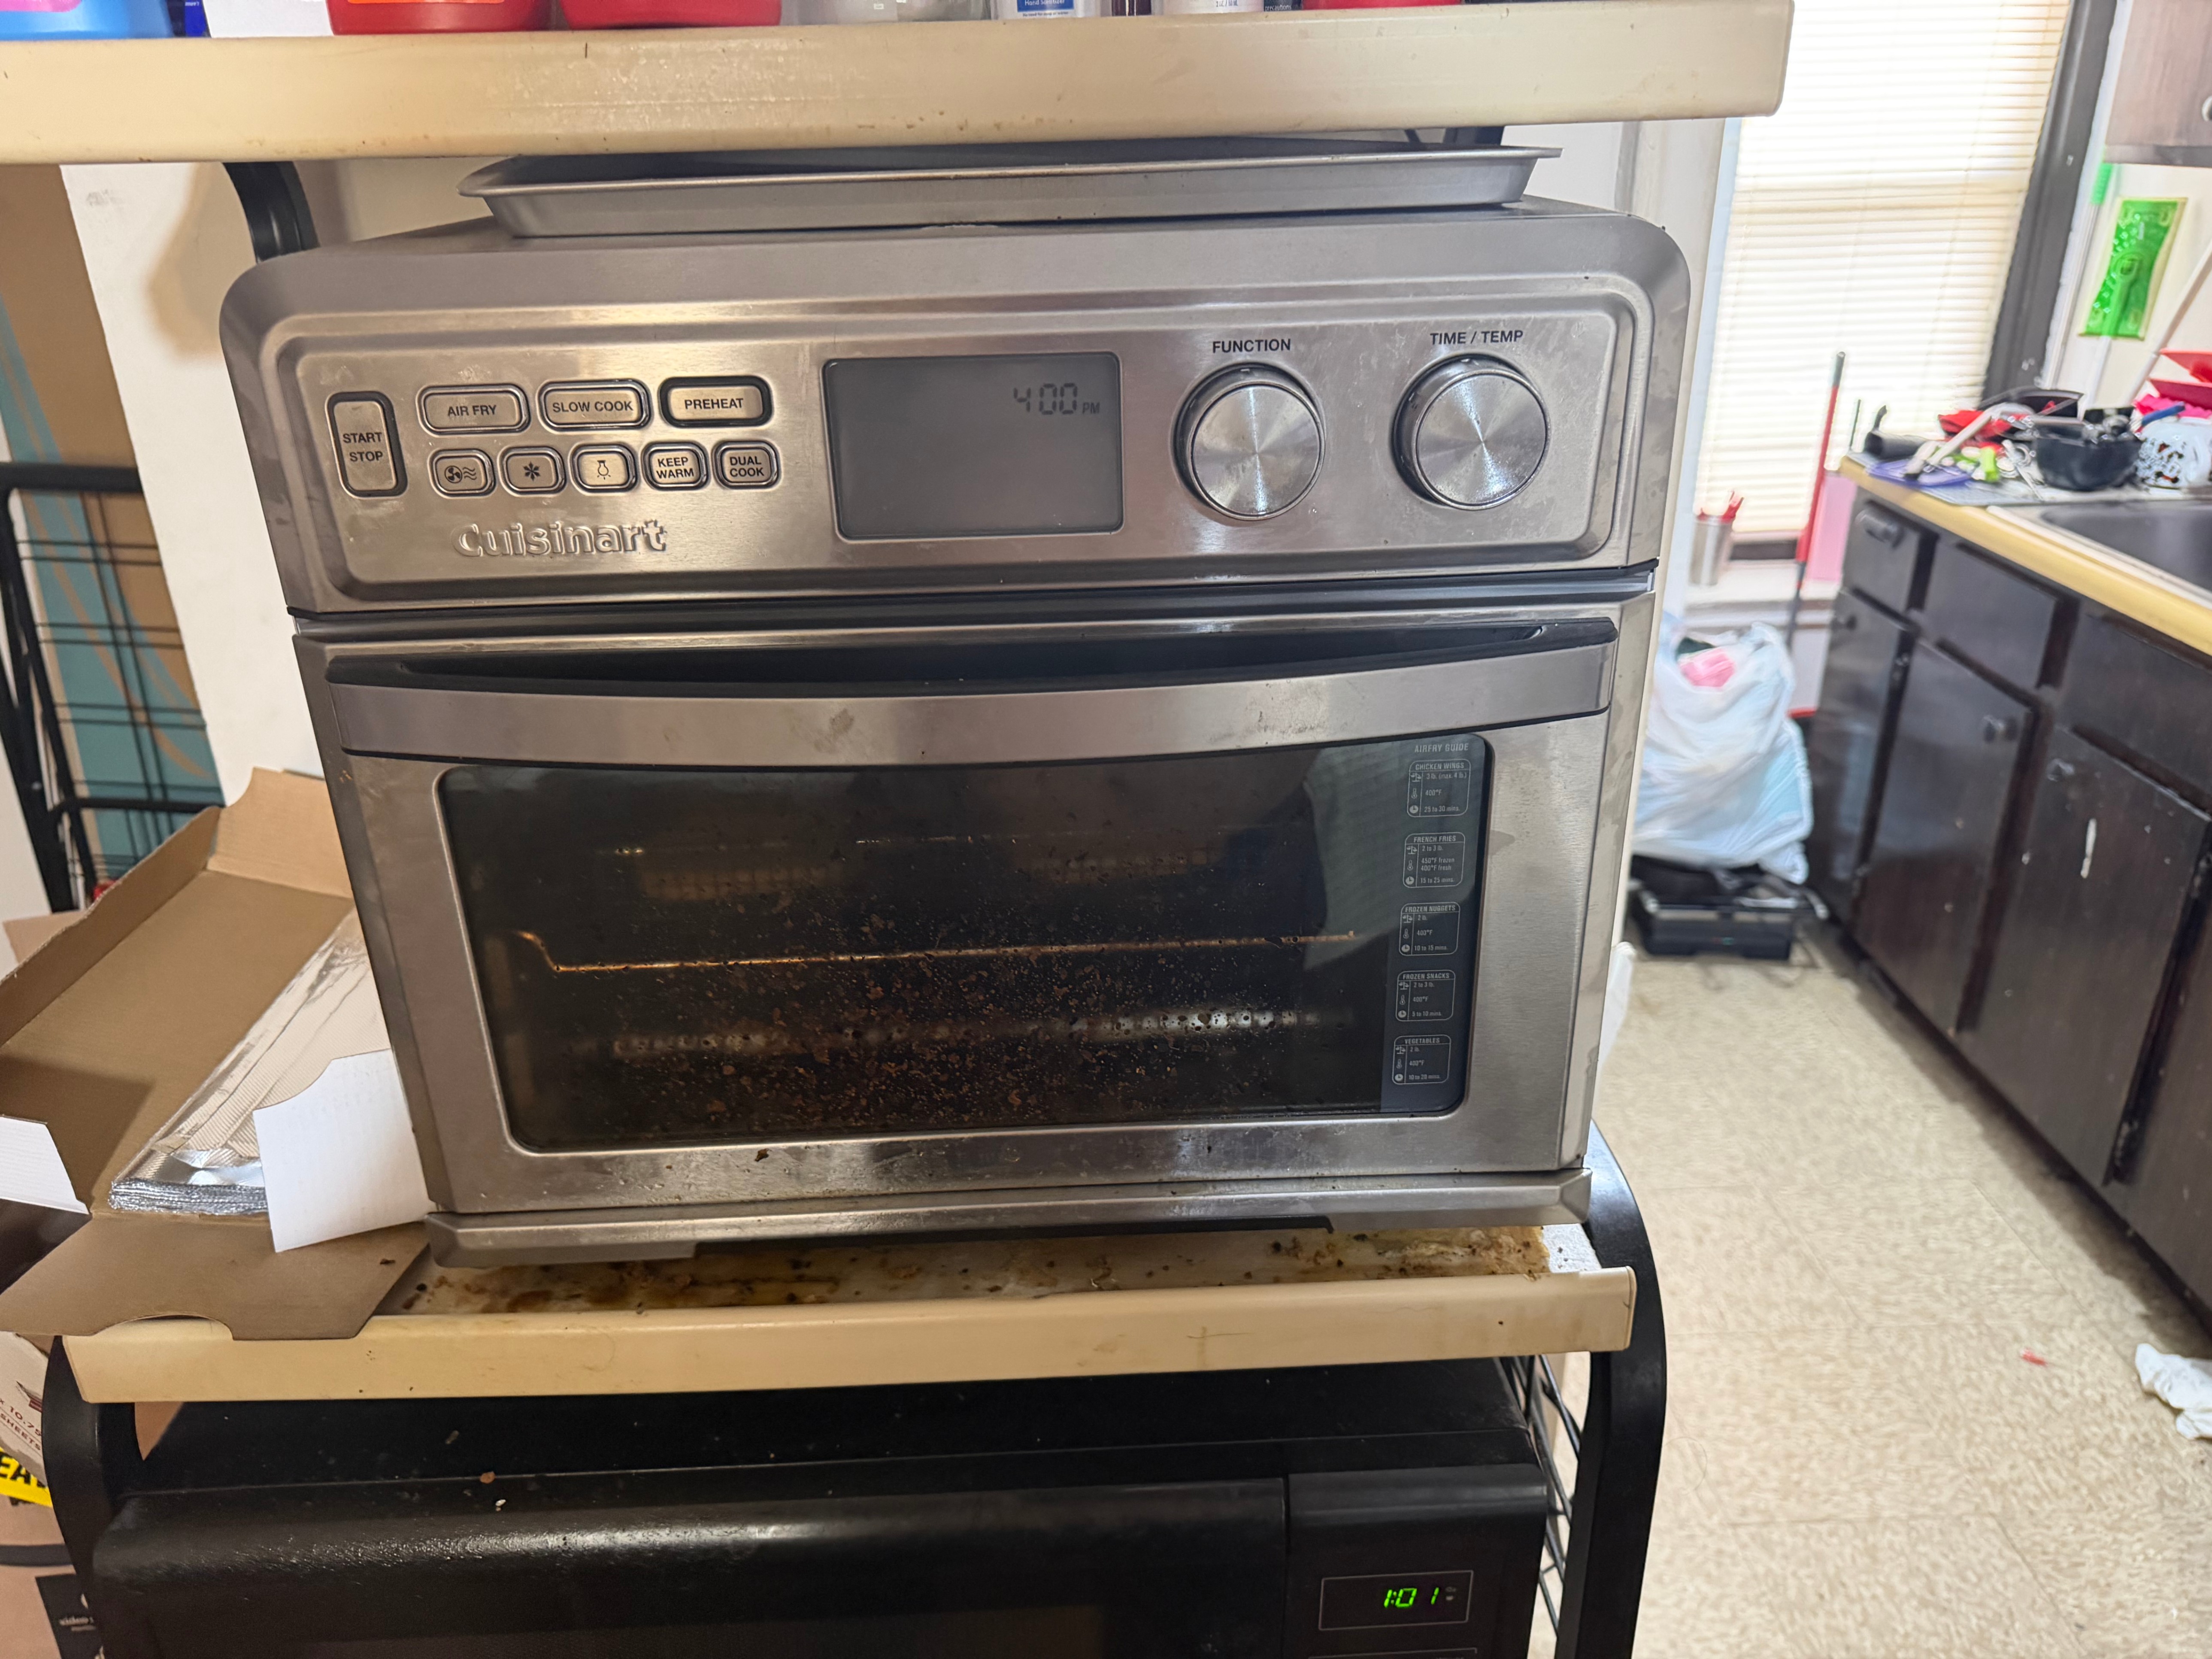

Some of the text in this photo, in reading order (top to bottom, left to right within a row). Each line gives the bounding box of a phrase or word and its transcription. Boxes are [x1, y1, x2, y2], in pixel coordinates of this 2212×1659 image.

[1430, 330, 1523, 345] TIME / TEMP
[1212, 339, 1291, 353] FUNCTION
[553, 401, 633, 412] SLOW COOK
[685, 398, 744, 410] PREHEAT
[1082, 402, 1100, 414] PM
[448, 405, 497, 416] AIR FRY
[343, 432, 382, 443] START
[350, 452, 383, 462] STOP
[658, 457, 688, 467] KEEP
[730, 456, 761, 466] DUAL
[656, 469, 694, 479] WARM
[730, 467, 764, 477] COOK
[452, 520, 666, 557] Cuisinart
[1445, 743, 1469, 751] GUIDE
[1, 1413, 41, 1450] SHEETS
[1384, 1587, 1439, 1608] 1:01
